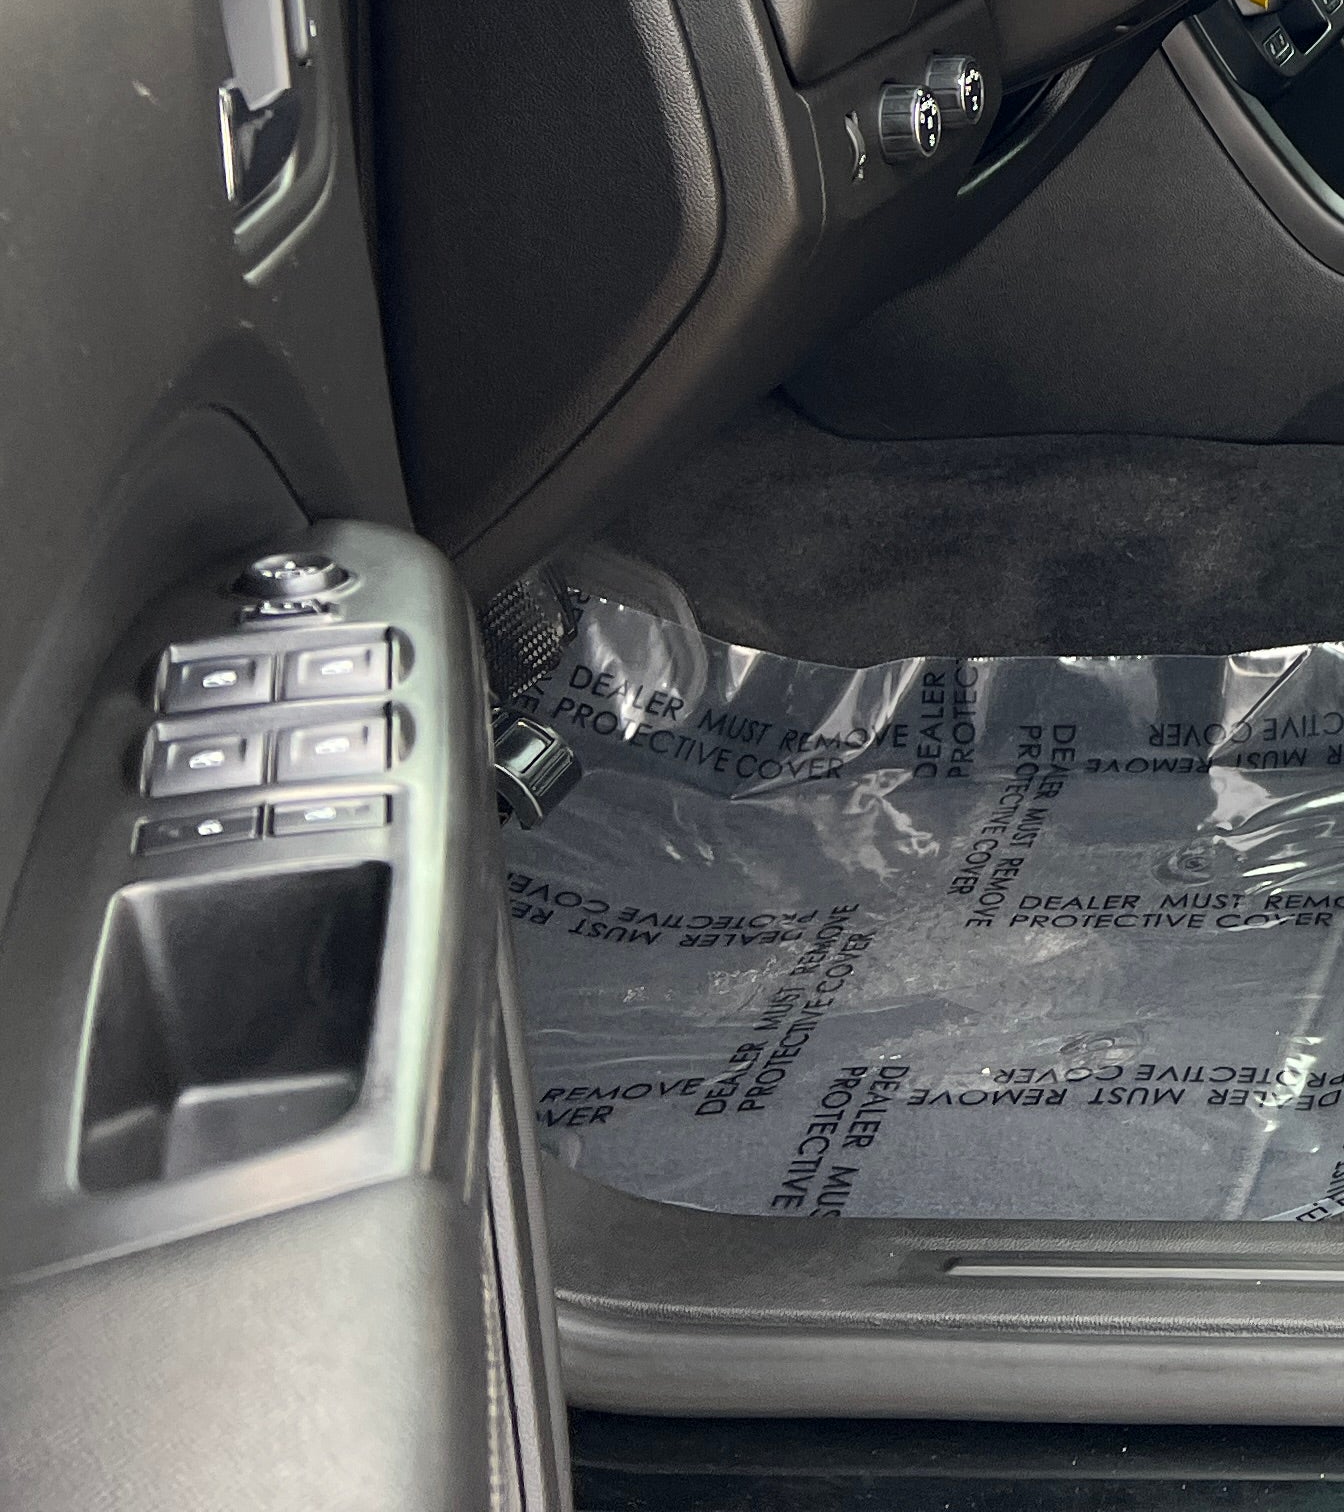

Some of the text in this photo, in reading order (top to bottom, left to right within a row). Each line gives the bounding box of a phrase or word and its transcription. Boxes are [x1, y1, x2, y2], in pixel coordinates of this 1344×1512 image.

[569, 665, 685, 722] DEALER
[696, 708, 773, 745] MUST
[778, 723, 909, 753] REMOVE
[946, 660, 979, 780] PROTEC
[552, 696, 845, 781] PROTECTIVE COVER
[912, 671, 946, 779] DEALER
[1148, 721, 1252, 746] COVER
[1086, 757, 1213, 775] REMOVE
[1236, 749, 1307, 770] MUST
[946, 724, 1043, 896] PROTECTIVE COVER
[965, 724, 1077, 928] DEALER MUST REMOVE
[1018, 893, 1142, 911] DEALER
[1160, 893, 1247, 911] MUST
[617, 904, 820, 931] PROTECTIVE
[1008, 911, 1335, 929] PROTECTIVE COVER
[568, 919, 663, 947] MUST
[678, 929, 805, 949] DEALER
[694, 902, 861, 1118] DEALER MUST REMOVE
[737, 929, 877, 1113] PROTECTIVE COVER
[992, 1064, 1125, 1085] COVER
[538, 1076, 707, 1104] REMOVE
[905, 1087, 1069, 1108] REMOVE
[1088, 1086, 1187, 1107] MUST
[841, 1065, 911, 1150] DEALER
[770, 1065, 869, 1211] PROTECTIVE
